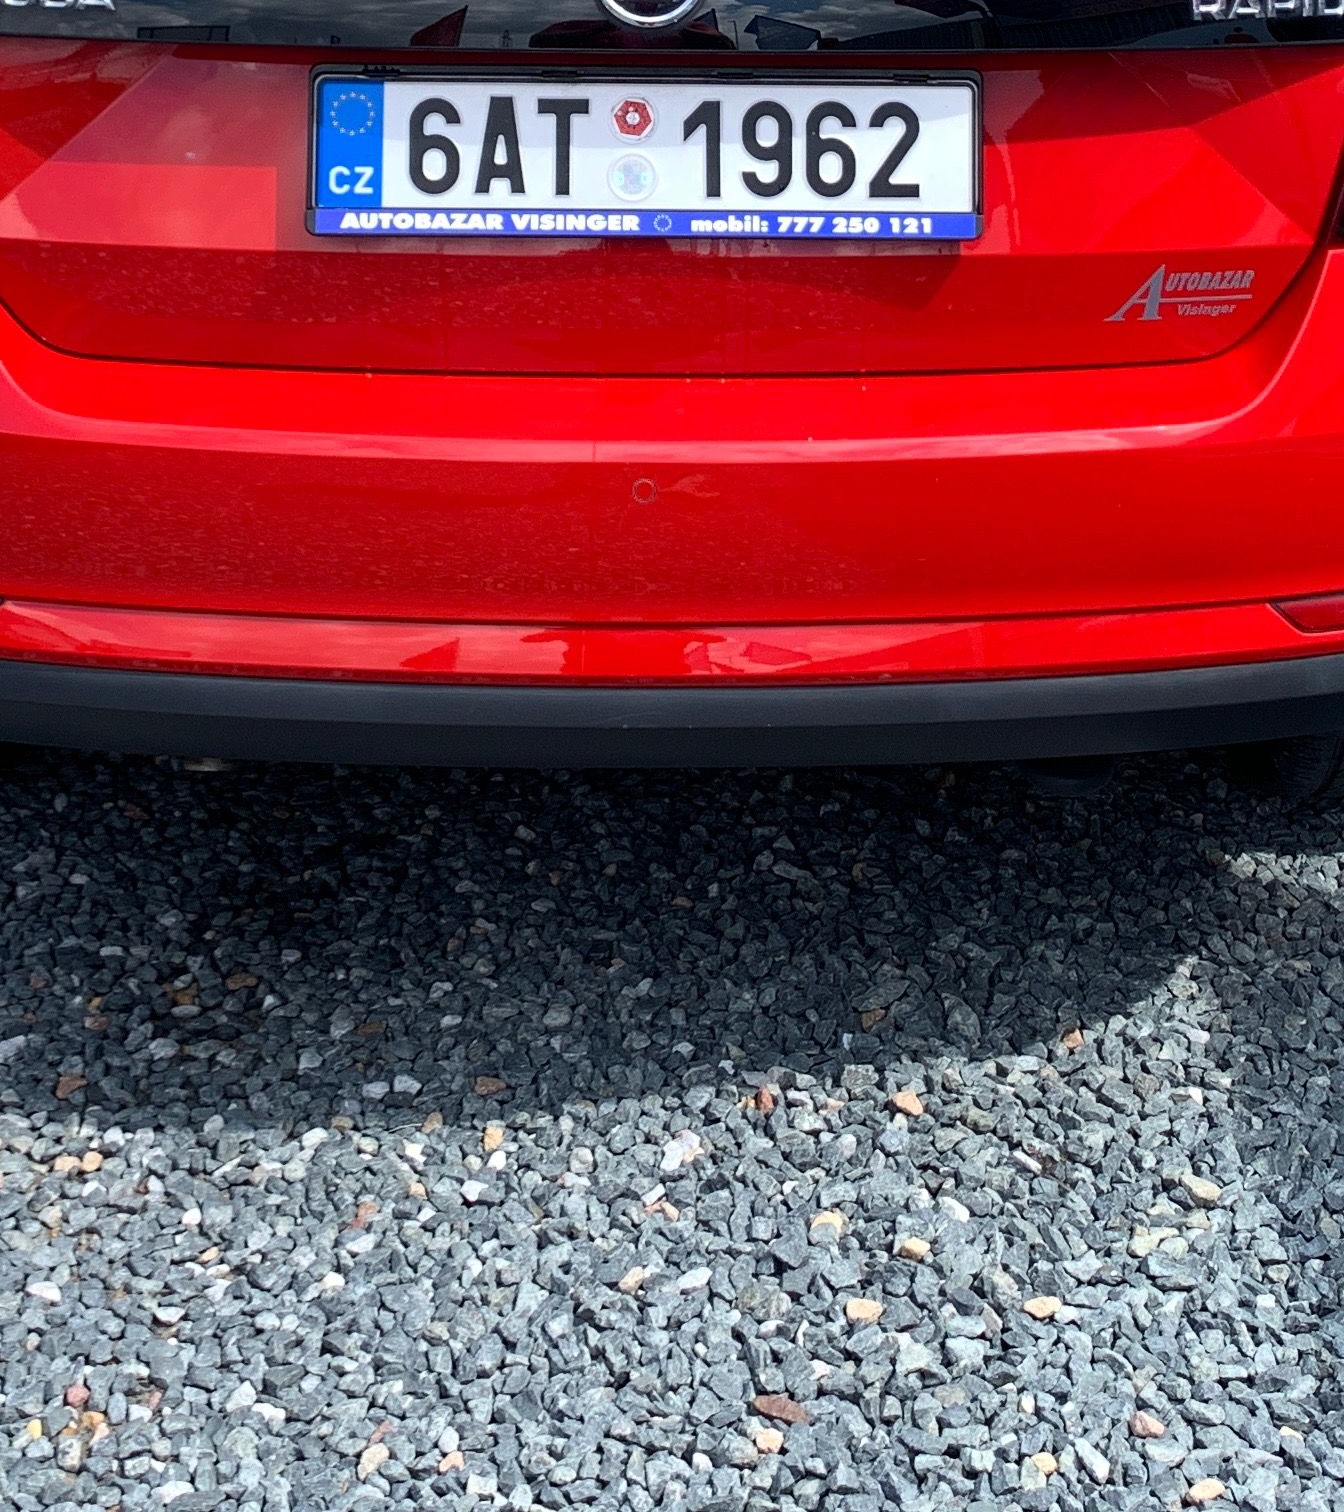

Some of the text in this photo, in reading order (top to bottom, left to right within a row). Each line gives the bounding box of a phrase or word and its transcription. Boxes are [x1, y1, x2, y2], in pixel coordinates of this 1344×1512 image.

[408, 95, 921, 199] 6AT 1962
[328, 166, 374, 194] CZ
[340, 212, 934, 235] AUTOBAZAR VISINGER mobil: 777 250 121
[1103, 263, 1255, 322] AUTOBAZAR
